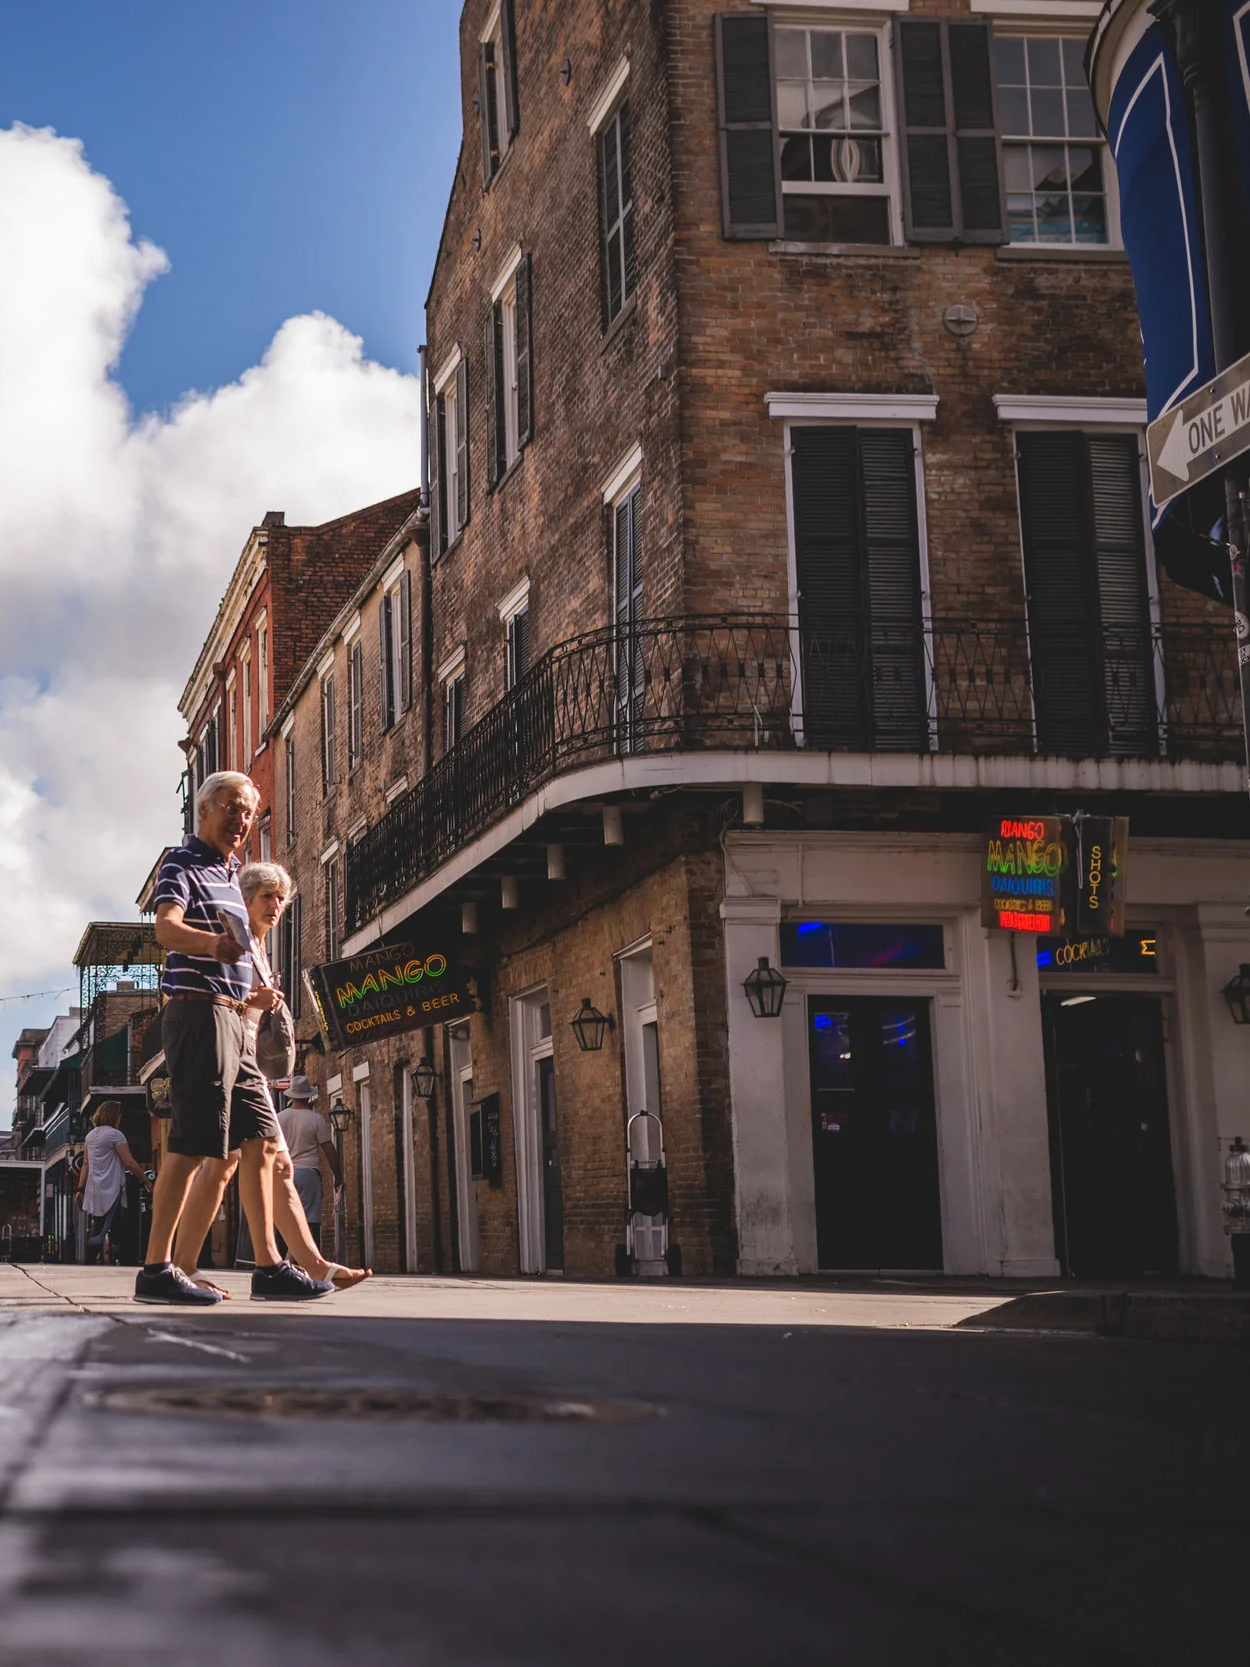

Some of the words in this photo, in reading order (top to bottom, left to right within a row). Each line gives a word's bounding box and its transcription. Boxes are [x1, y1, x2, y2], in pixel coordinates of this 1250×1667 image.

[1188, 404, 1226, 454] ONE
[987, 840, 1062, 876] MANGO
[1089, 845, 1101, 909] SHOTS
[335, 953, 447, 1009] MANGO
[350, 943, 415, 974] MANGO
[346, 1009, 402, 1034] COCKTAILS
[406, 1005, 416, 1017] &
[422, 993, 461, 1012] BEER
